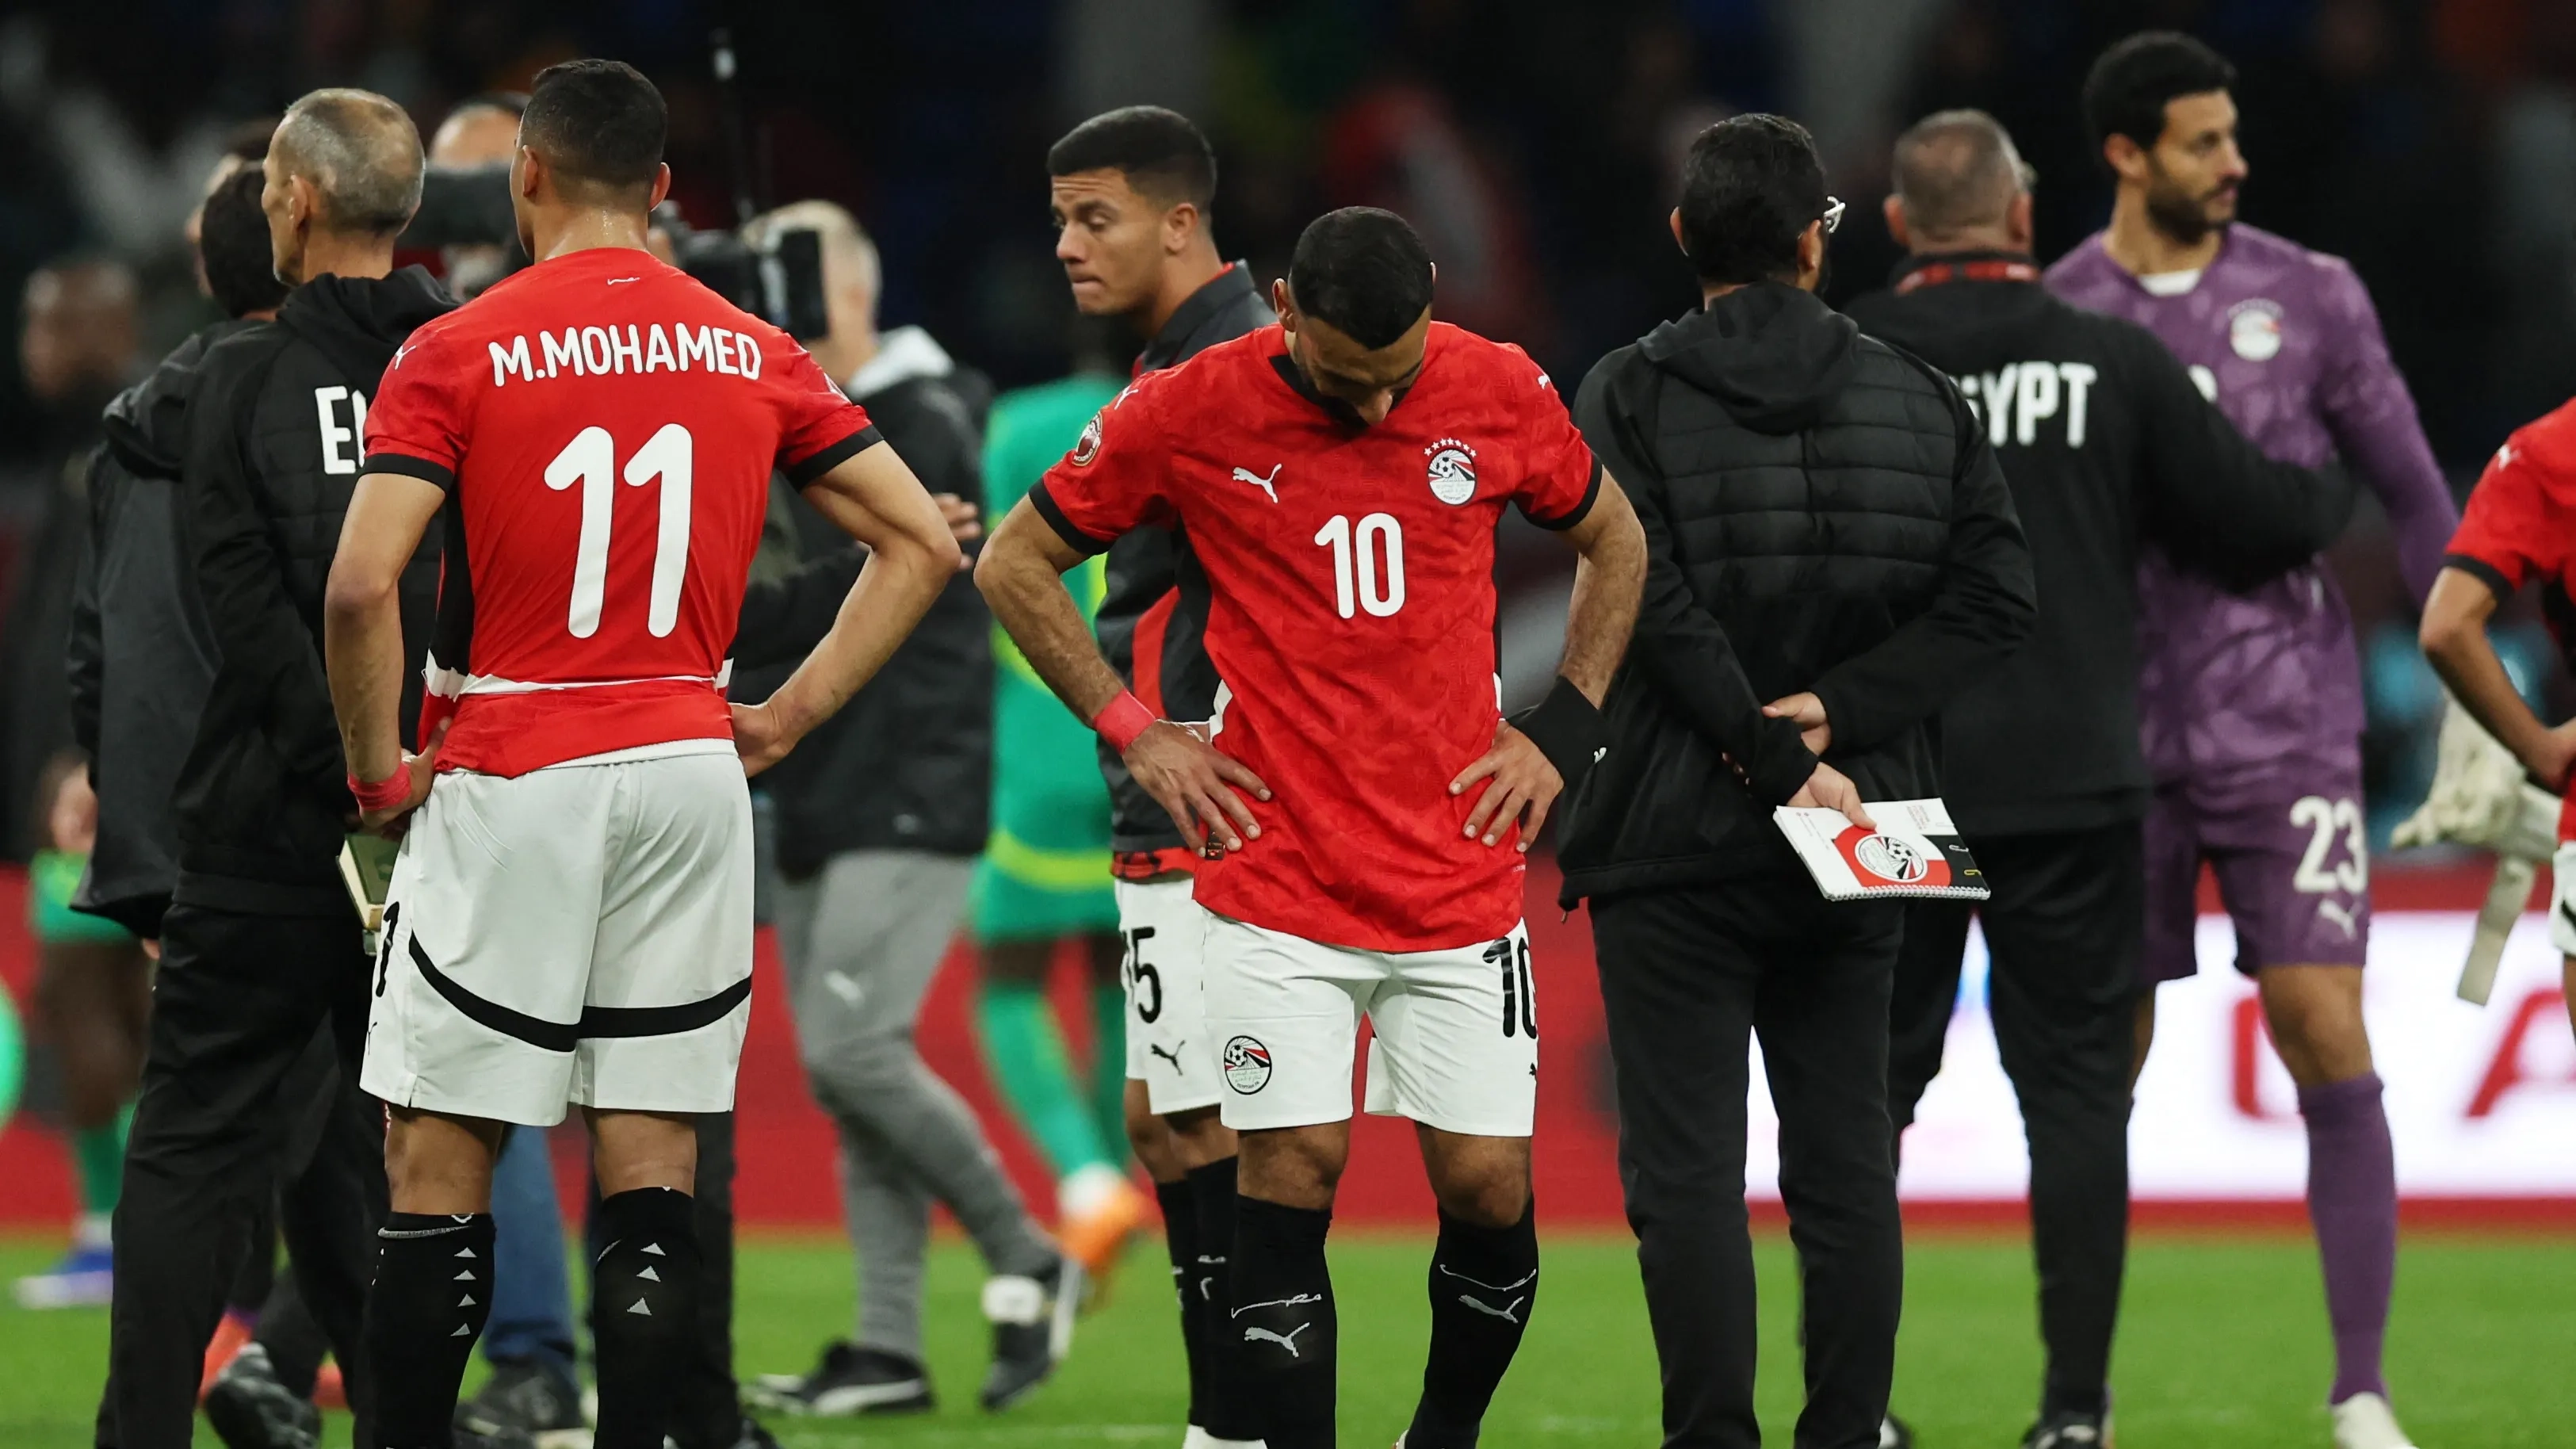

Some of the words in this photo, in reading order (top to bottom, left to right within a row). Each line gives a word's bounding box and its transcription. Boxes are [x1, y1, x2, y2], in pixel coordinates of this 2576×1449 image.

[488, 323, 761, 387] M.MOHAMED
[545, 423, 692, 638] 11
[1314, 512, 1405, 619] 10
[2289, 795, 2368, 893] 23
